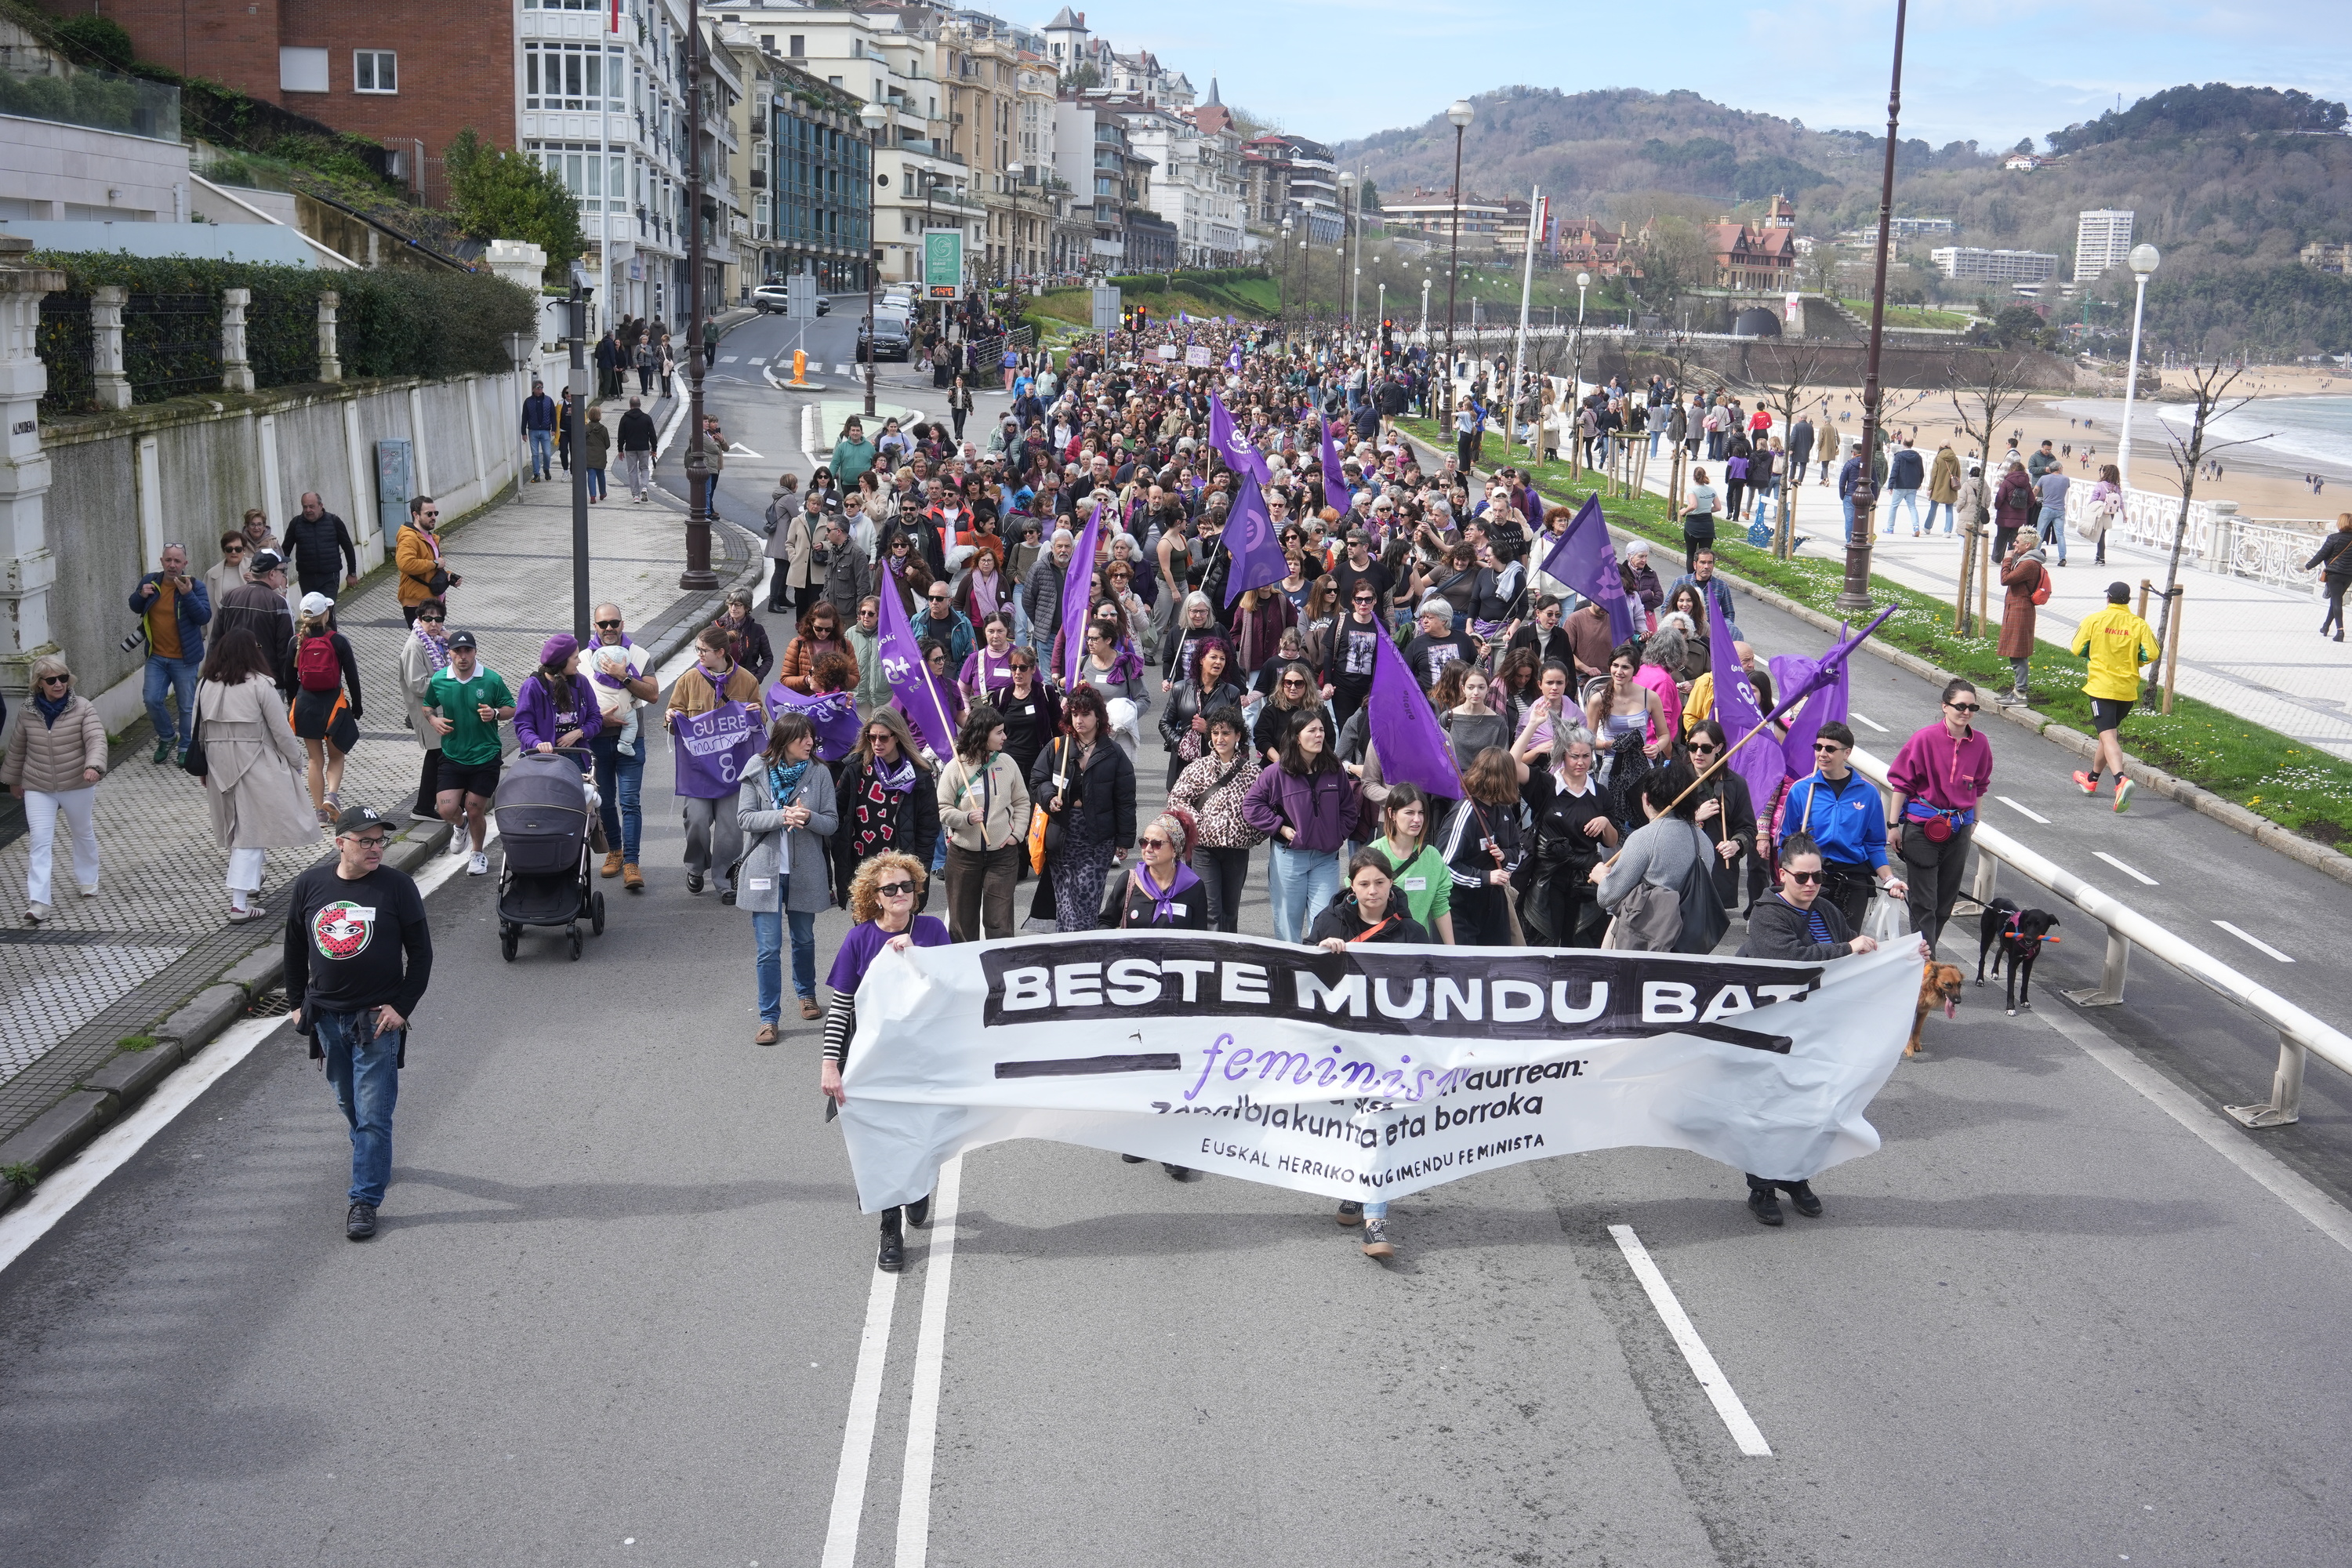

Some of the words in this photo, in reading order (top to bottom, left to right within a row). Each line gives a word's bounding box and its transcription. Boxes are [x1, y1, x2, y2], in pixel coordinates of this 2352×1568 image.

[693, 720, 715, 737] GU
[719, 753, 736, 783] 8
[325, 902, 338, 912] FREE
[1002, 959, 1271, 1012] BESTE
[1295, 971, 1610, 1022] MUNDU
[1642, 981, 1809, 1023] BAT
[1385, 1113, 1426, 1147] eta
[1435, 1091, 1544, 1131] borroka
[1200, 1138, 1271, 1168] EUSKAL
[1277, 1154, 1356, 1183] HERRIKO
[1358, 1152, 1454, 1188] MUGIMENDU
[1458, 1134, 1545, 1166] FEMINISTA
